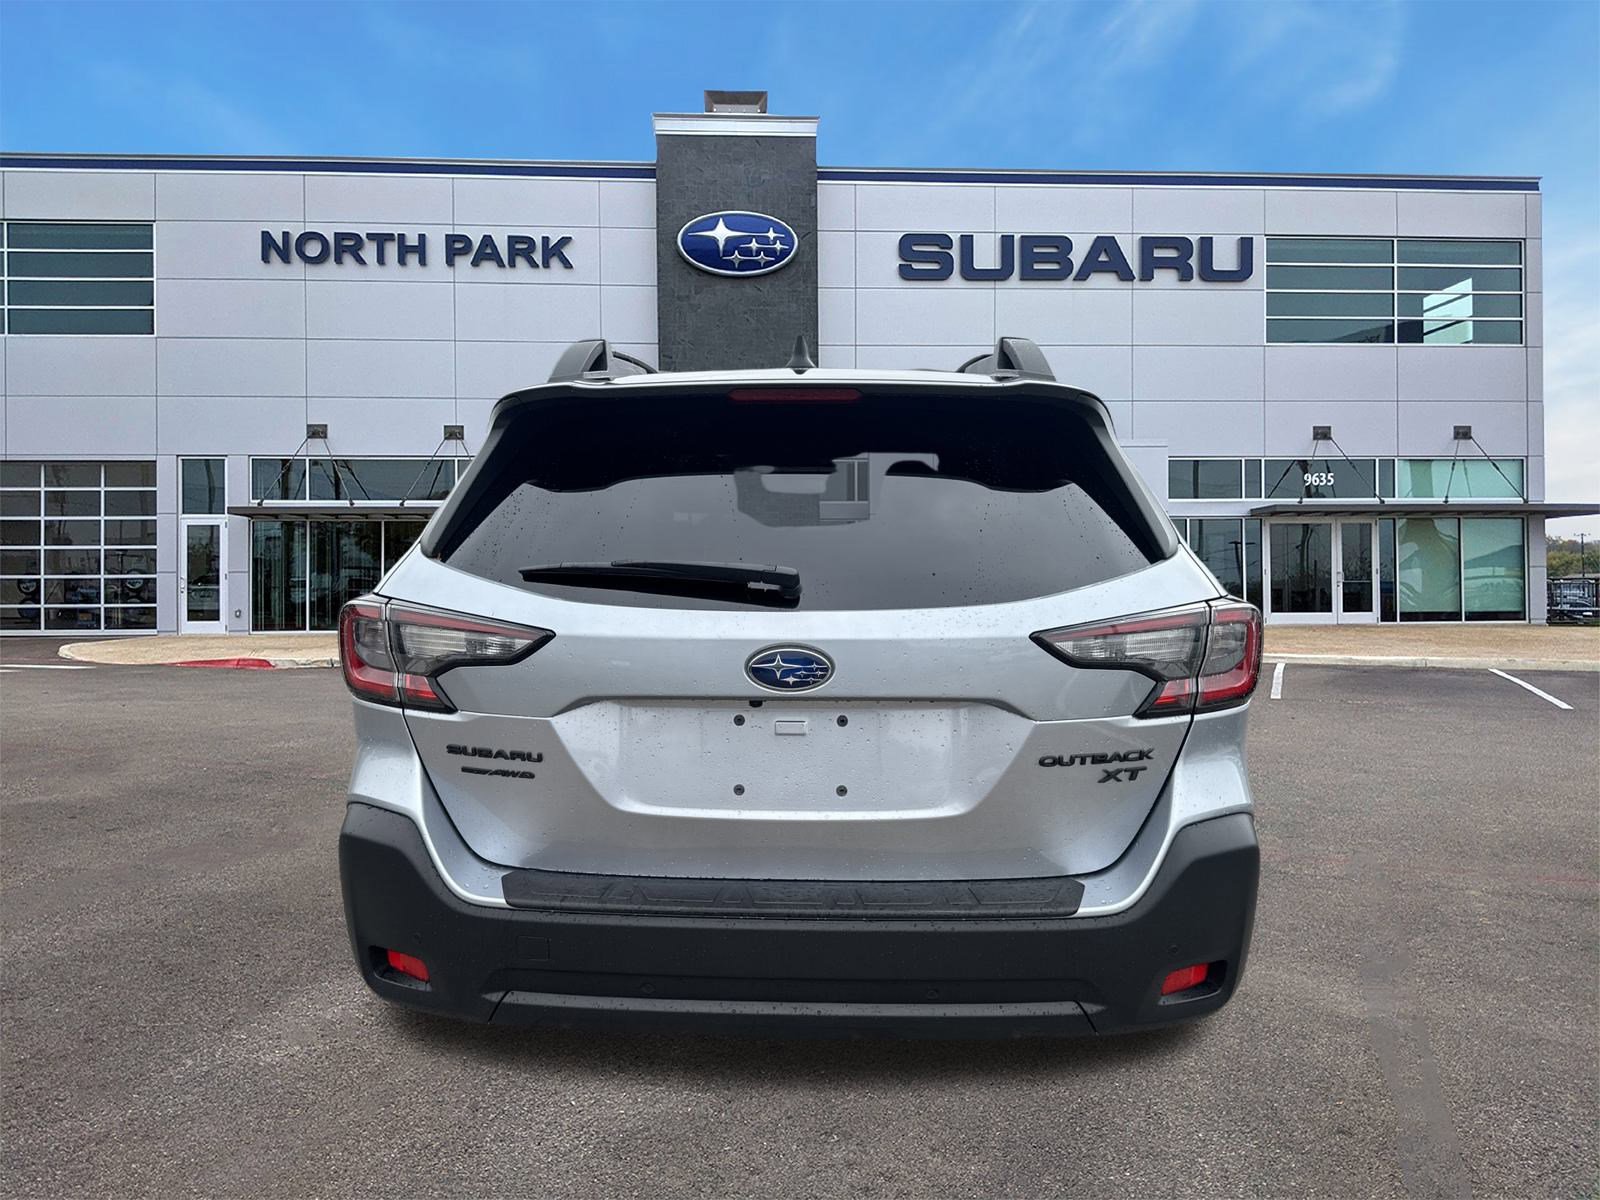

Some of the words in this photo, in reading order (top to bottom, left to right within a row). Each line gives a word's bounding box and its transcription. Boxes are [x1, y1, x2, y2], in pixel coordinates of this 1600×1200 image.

[260, 230, 427, 267] NORTH
[444, 233, 574, 269] PARK
[898, 233, 1254, 282] SUBARU
[1303, 472, 1335, 487] 9635
[446, 744, 543, 763] SUBARU
[1038, 748, 1154, 767] OUTBACK
[487, 768, 536, 779] AWD
[1097, 765, 1148, 783] XT
